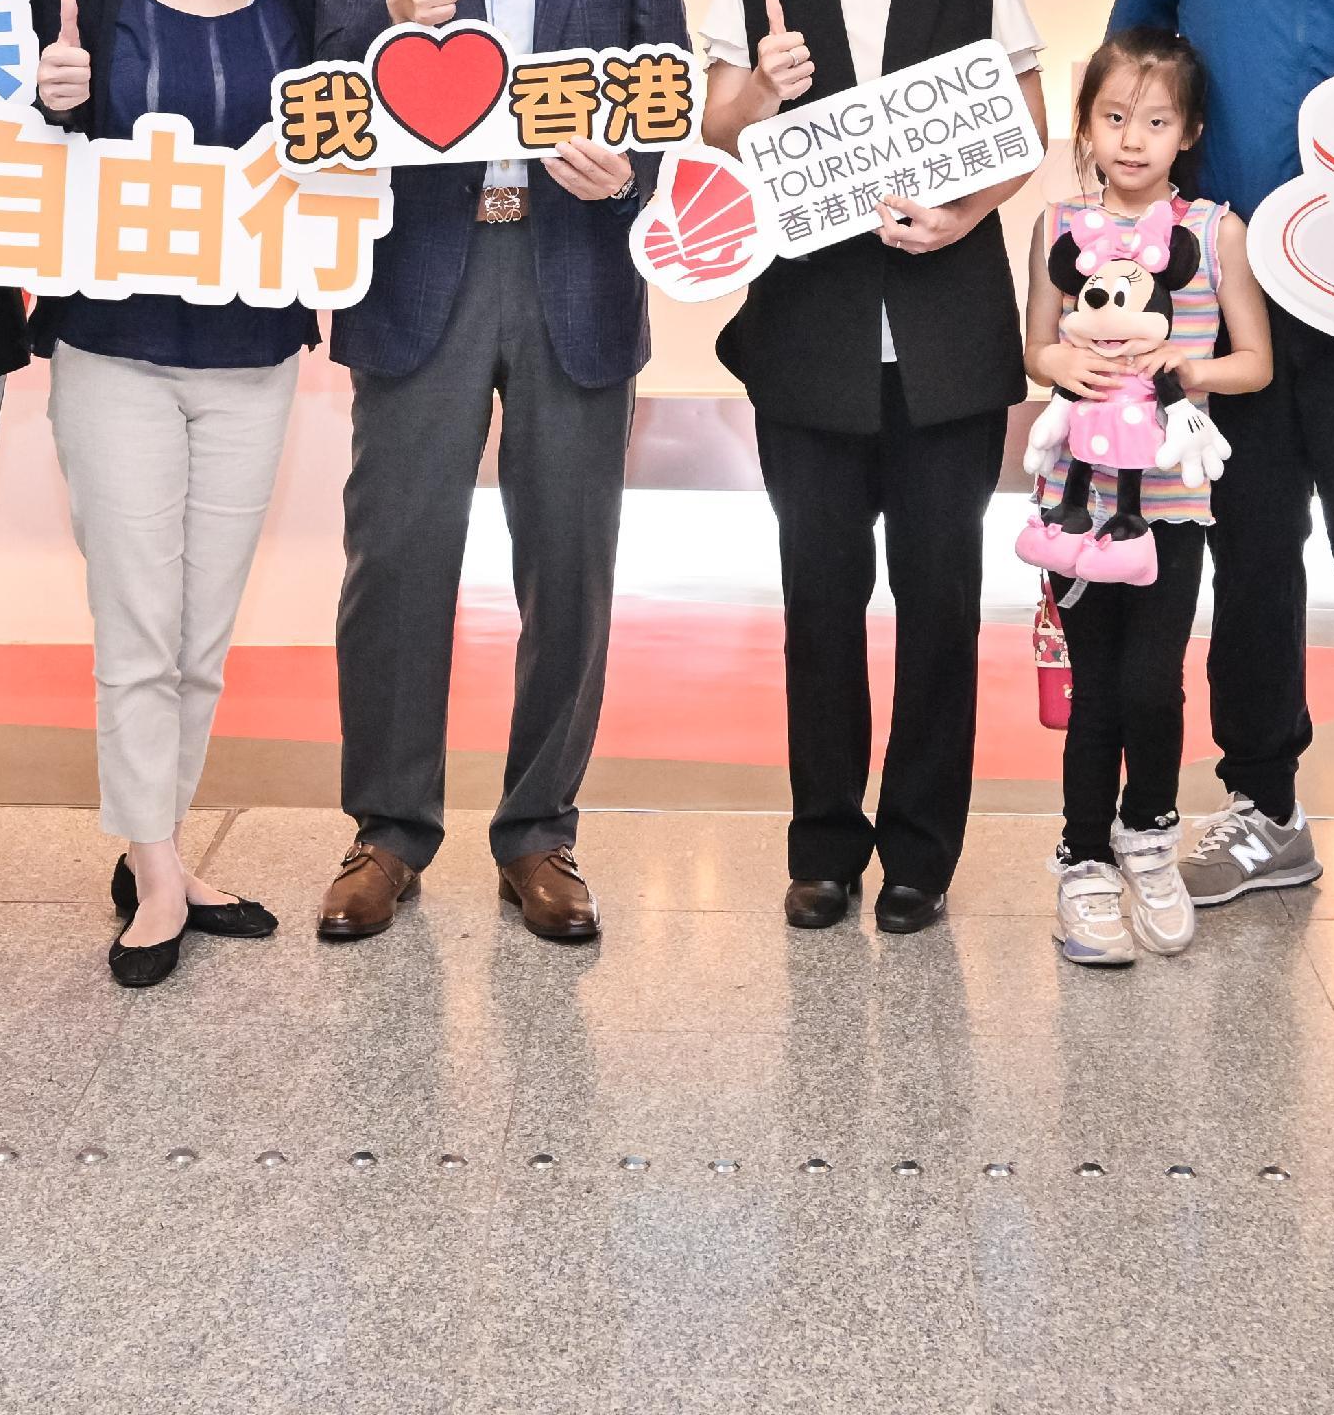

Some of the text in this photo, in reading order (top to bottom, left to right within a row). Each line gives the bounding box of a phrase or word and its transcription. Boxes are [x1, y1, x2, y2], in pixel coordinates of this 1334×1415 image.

[281, 53, 692, 166] 我 香港
[750, 57, 1000, 172] HONG KONG
[764, 95, 1014, 203] TOURISM BOARD
[778, 126, 1030, 243] 香港旅游发展局
